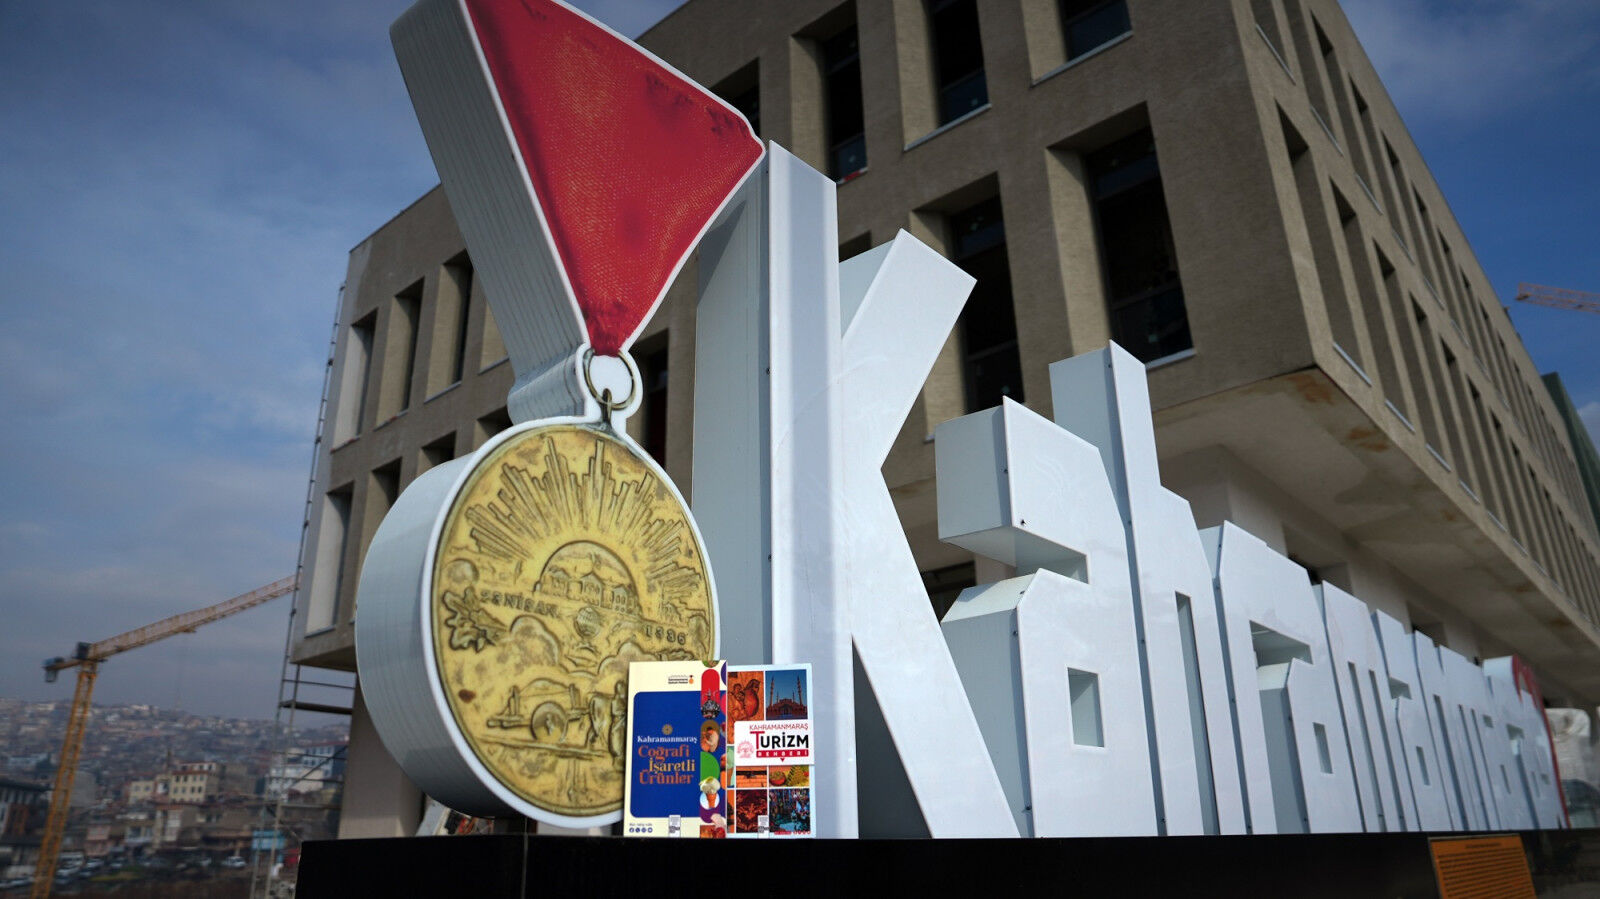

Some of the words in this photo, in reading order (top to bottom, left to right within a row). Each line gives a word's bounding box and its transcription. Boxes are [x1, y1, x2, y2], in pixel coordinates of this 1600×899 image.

[749, 723, 809, 731] KAHRAMANMARAŞ
[637, 735, 698, 744] Kahramanmaraş
[749, 731, 809, 749] TURİZM
[638, 744, 690, 763] Coğrafi
[649, 757, 696, 774] İşaretli
[639, 769, 694, 785] Ürünler
